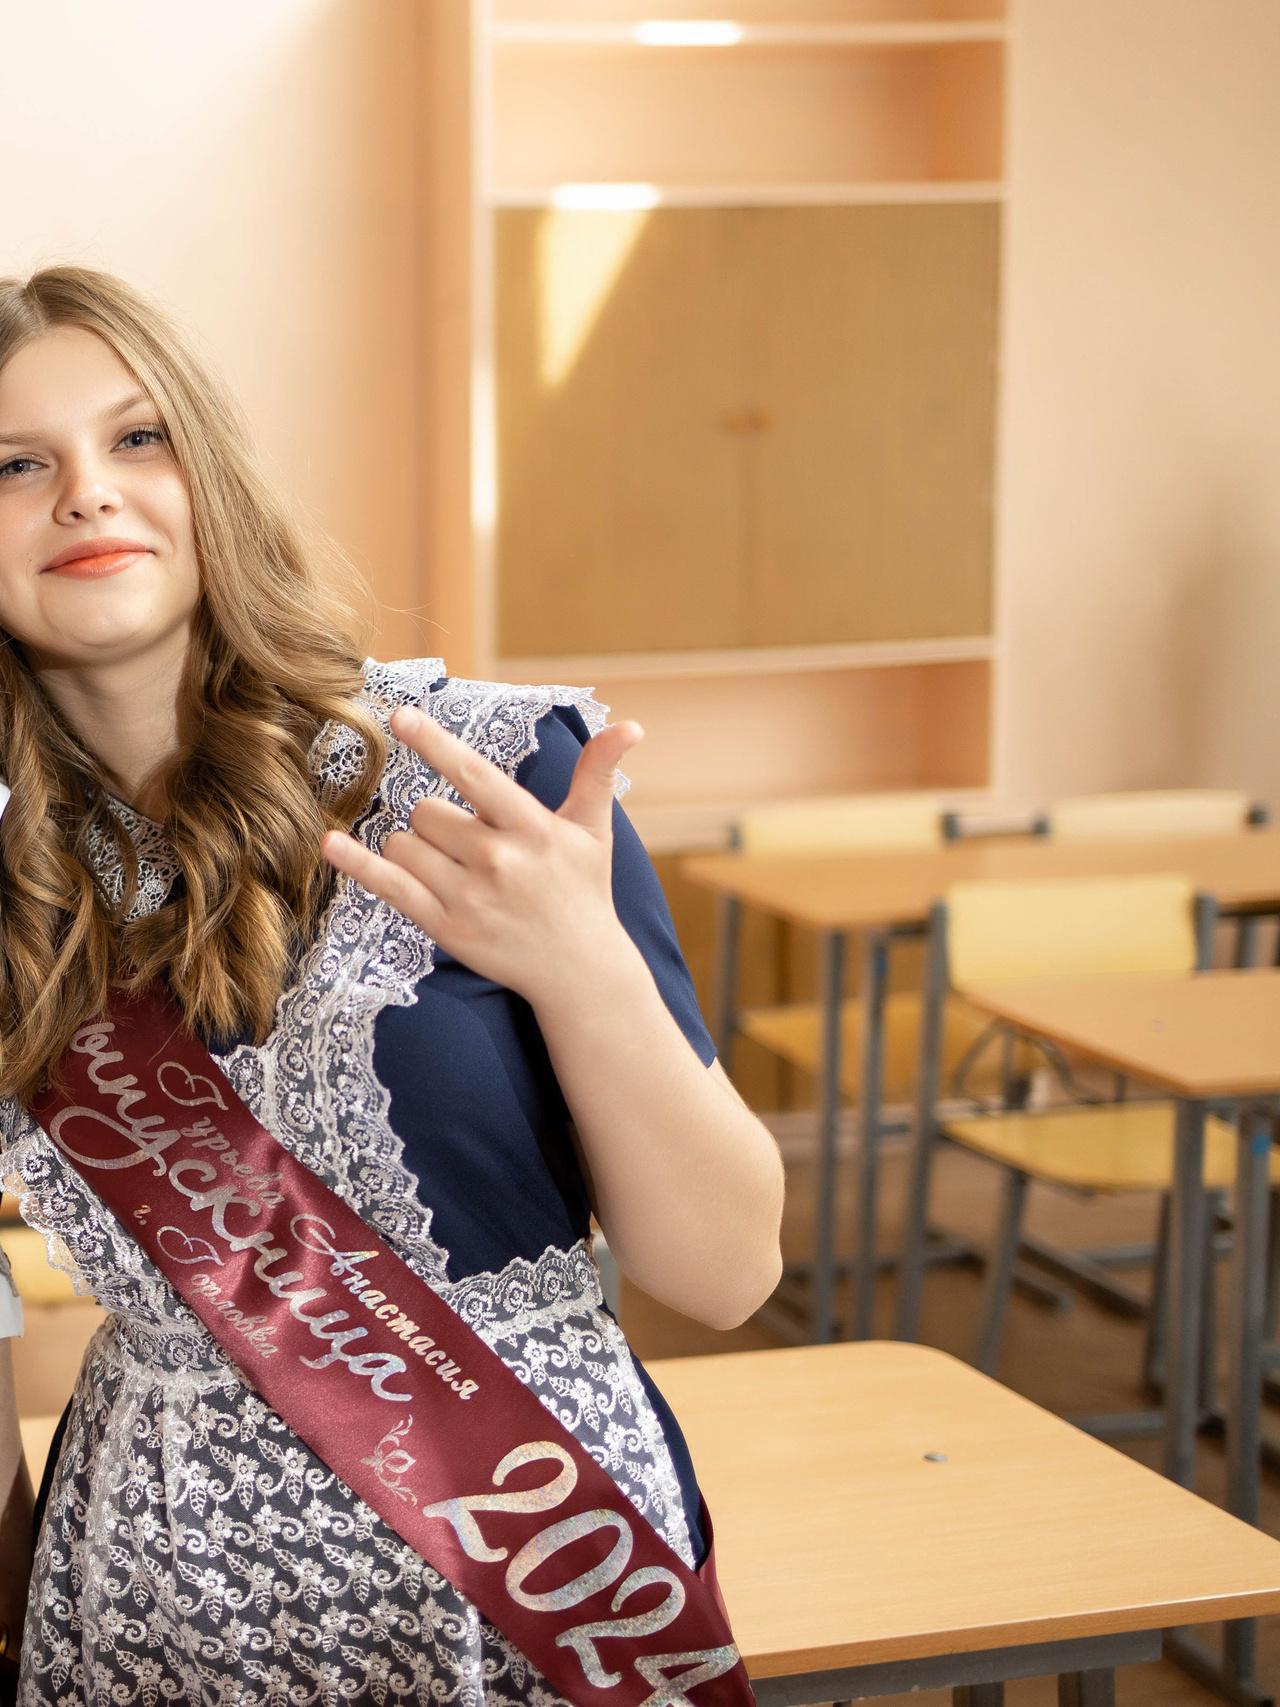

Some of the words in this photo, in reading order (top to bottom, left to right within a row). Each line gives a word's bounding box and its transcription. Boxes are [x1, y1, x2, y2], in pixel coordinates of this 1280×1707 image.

[50, 978, 413, 1402] ыпускница
[133, 1205, 151, 1225] г.
[156, 1226, 278, 1359] Горловка
[156, 1061, 286, 1211] Гурьева
[289, 1214, 480, 1401] Анастасия
[423, 1441, 741, 1707] 2024
